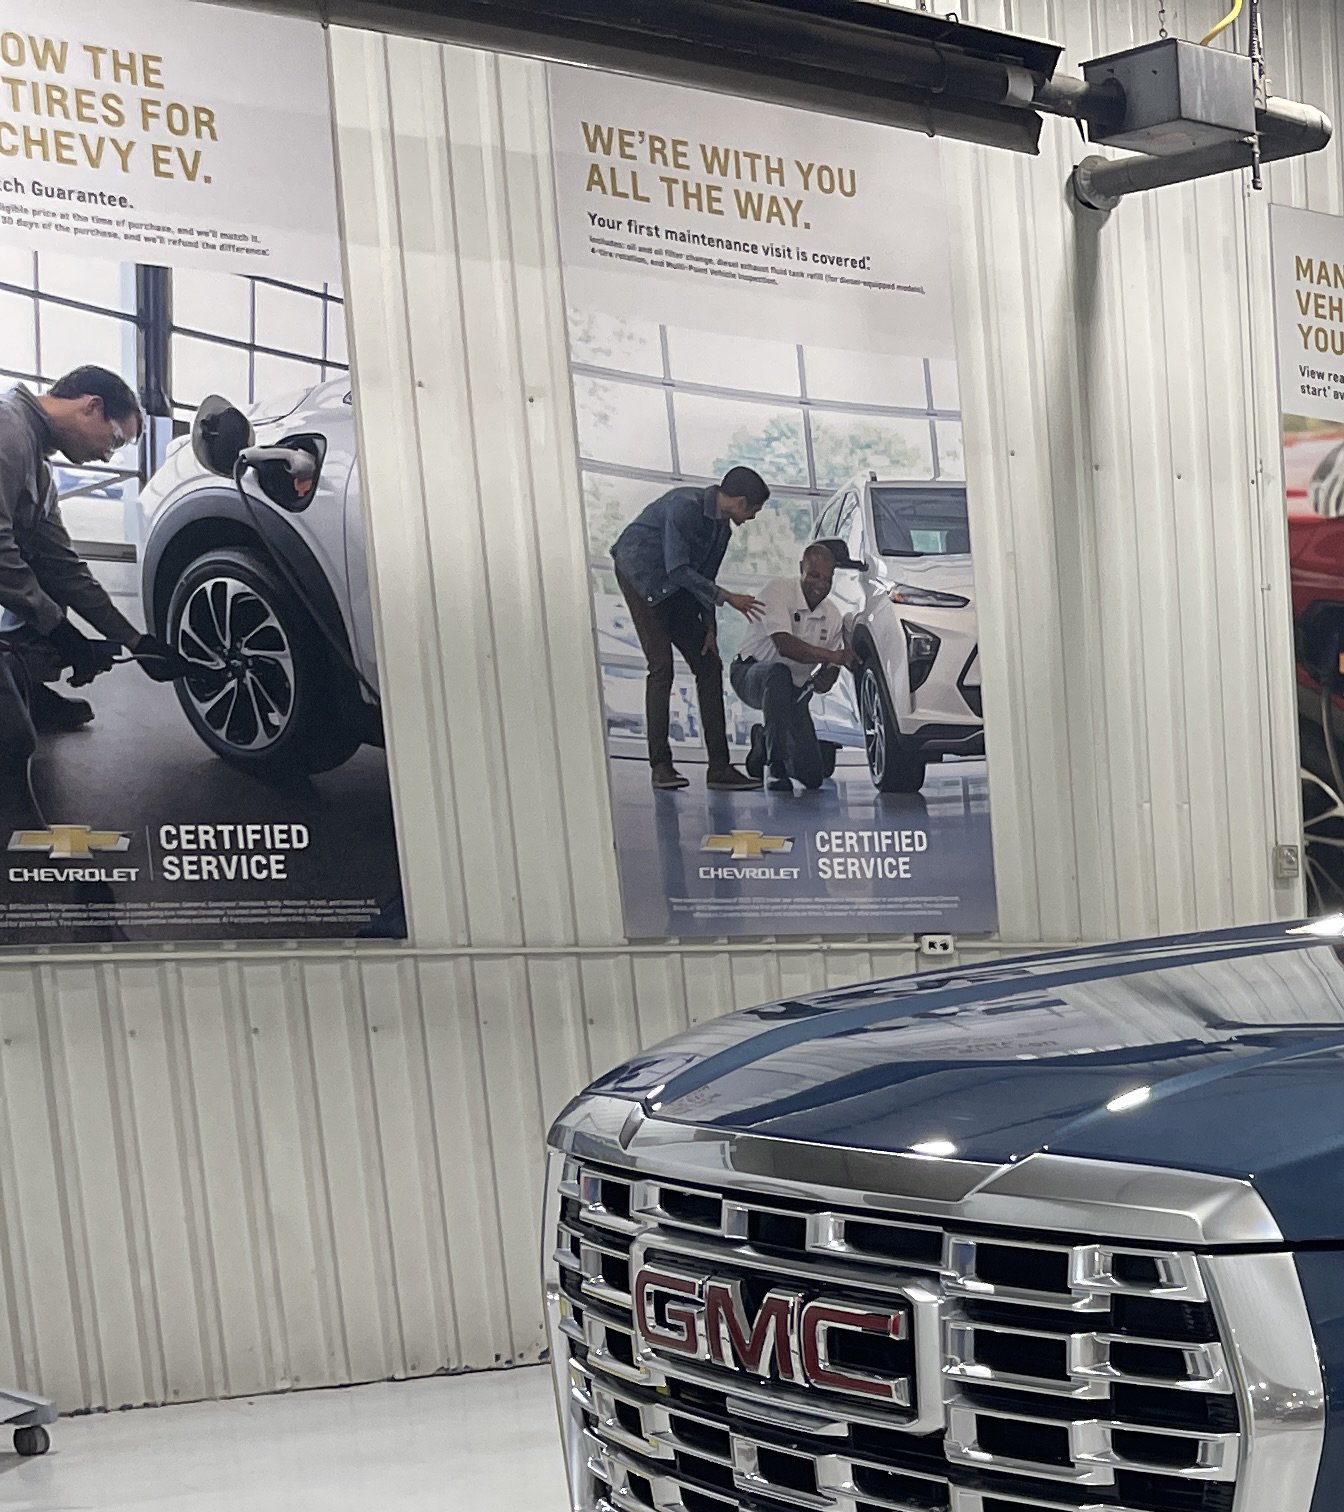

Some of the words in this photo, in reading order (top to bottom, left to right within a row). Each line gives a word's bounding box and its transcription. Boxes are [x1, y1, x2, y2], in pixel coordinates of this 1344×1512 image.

[0, 31, 69, 74] OW
[83, 44, 165, 90] THE
[1, 77, 126, 128] TIRES
[140, 98, 218, 142] FOR
[0, 122, 136, 173] CHEVY
[152, 144, 213, 184] EV.
[581, 120, 691, 171] WE'RE
[699, 143, 786, 188] WITH
[794, 159, 858, 198] YOU
[31, 180, 134, 209] Guarantee.
[585, 163, 650, 203] ALL
[658, 176, 725, 216] THE
[733, 188, 811, 230] WAY.
[587, 211, 622, 231] Your
[626, 219, 661, 239] first
[664, 228, 759, 255] maintenance
[761, 242, 793, 260] visit
[796, 246, 808, 262] is
[1299, 364, 1325, 381] View
[159, 823, 310, 851] CERTIFIED
[815, 830, 928, 853] CERTIFIED
[8, 867, 140, 883] CHEVROLET
[162, 854, 288, 882] SERVICE
[699, 866, 801, 880] CHEVROLET
[817, 856, 912, 880] SERVICE
[634, 1265, 911, 1408] GMC
